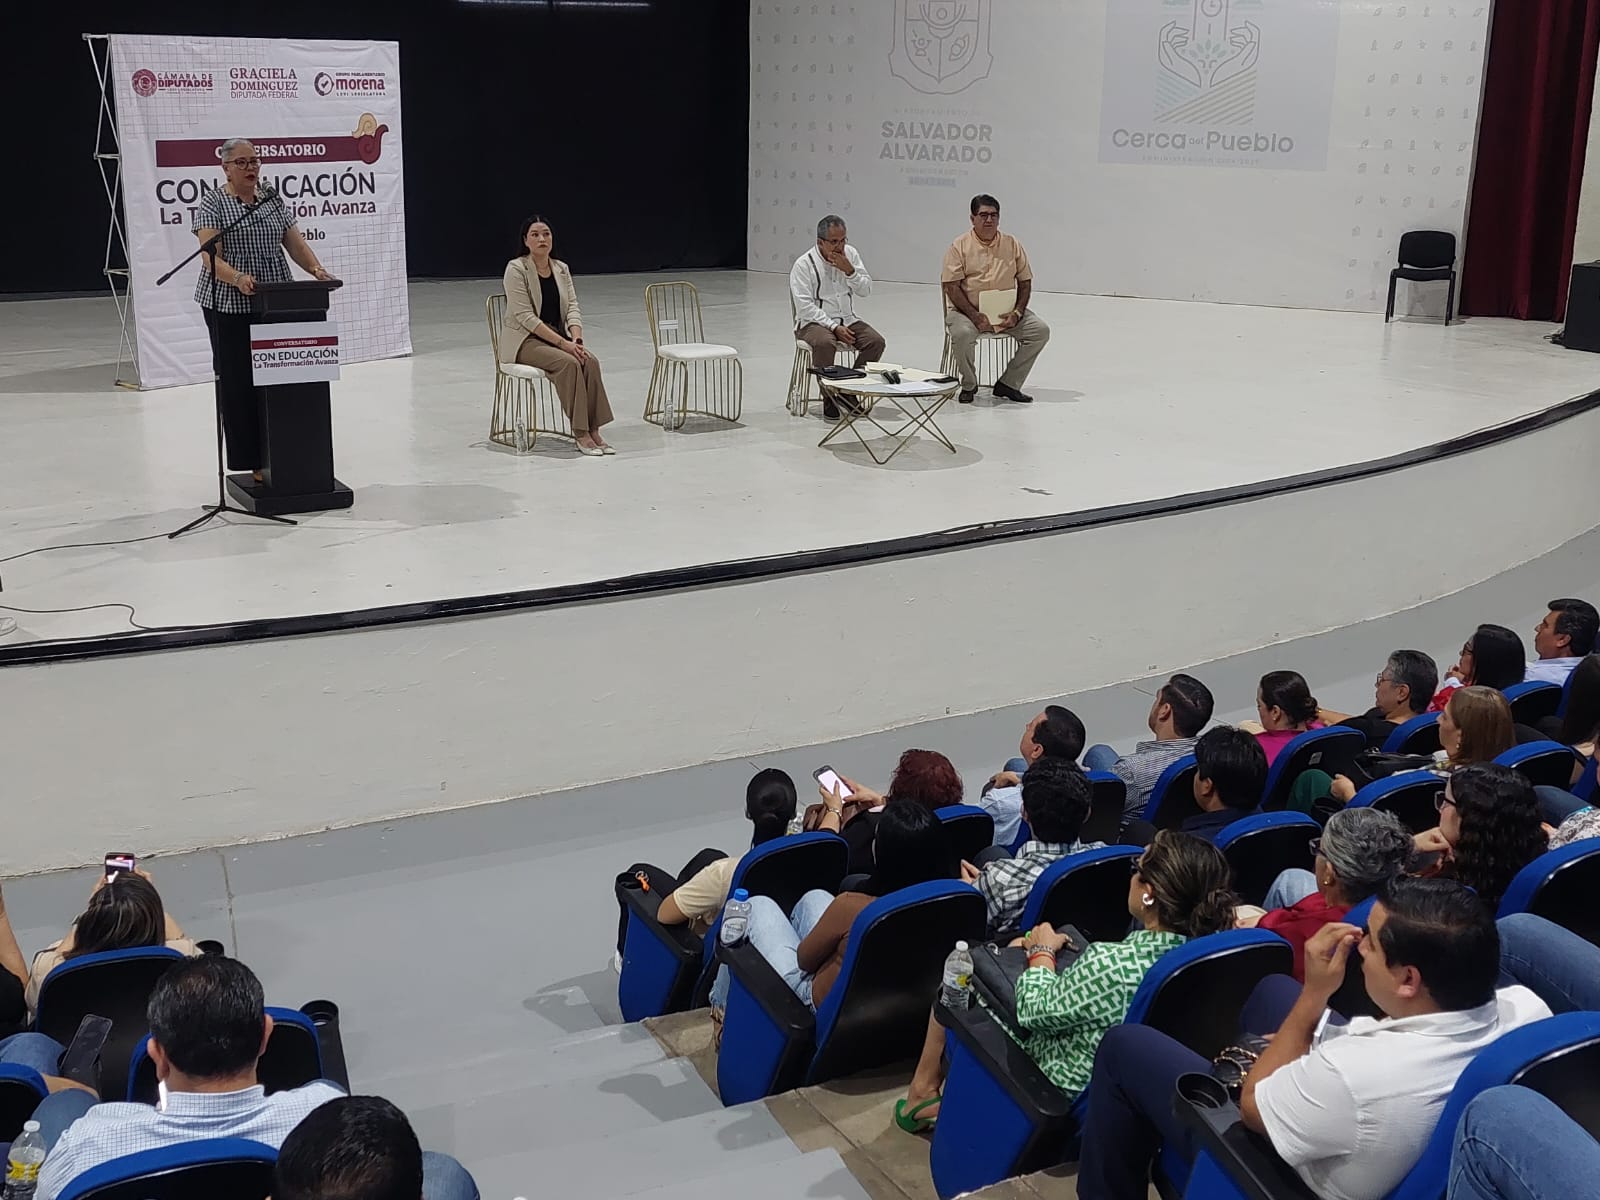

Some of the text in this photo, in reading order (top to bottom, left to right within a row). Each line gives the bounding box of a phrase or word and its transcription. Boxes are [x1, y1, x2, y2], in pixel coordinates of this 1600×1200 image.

[230, 67, 297, 79] GRACIELA
[157, 80, 213, 88] DIPUTADOS
[335, 79, 386, 90] morena
[231, 91, 299, 99] DIPUTADA FEDERAL
[880, 120, 993, 142] SALVADOR
[1112, 128, 1294, 153] Cerca del Pueblo
[879, 142, 993, 164] ALVARADO
[160, 207, 182, 224] La
[321, 200, 376, 217] Avanza
[252, 347, 339, 362] CON EDUCACIÓN
[263, 359, 314, 368] Transformación
[315, 358, 339, 366] Avanza
